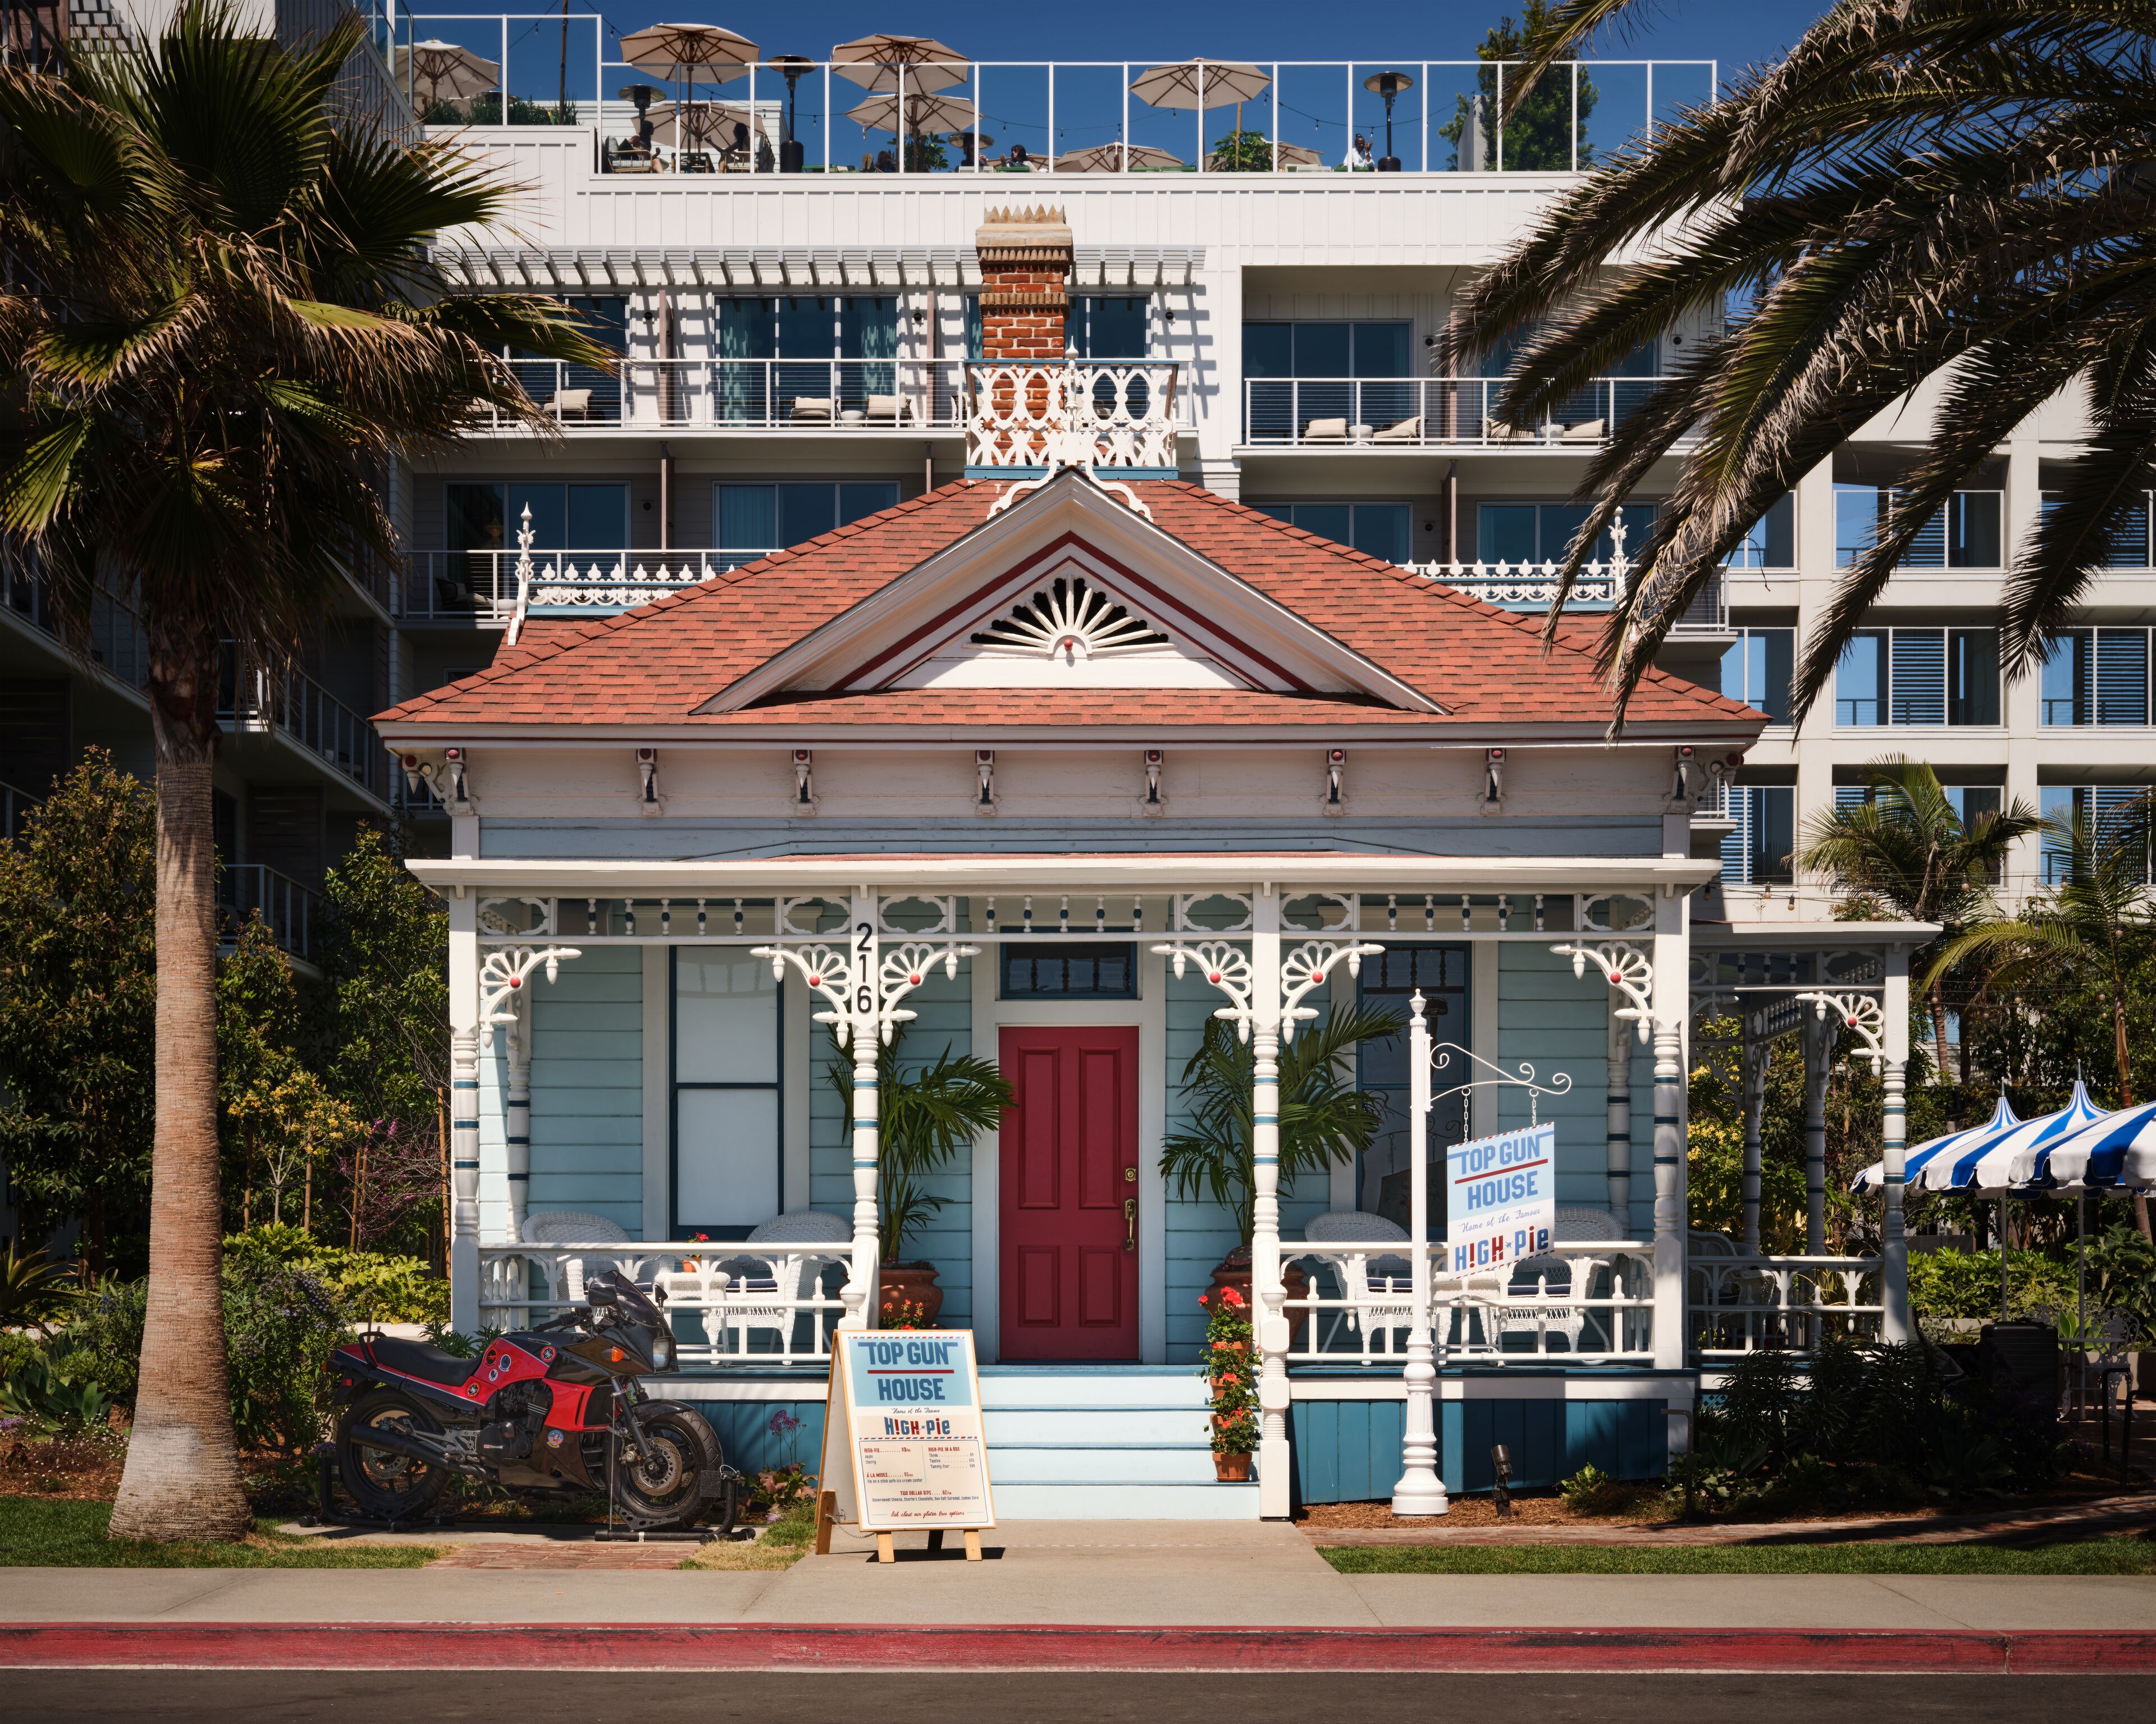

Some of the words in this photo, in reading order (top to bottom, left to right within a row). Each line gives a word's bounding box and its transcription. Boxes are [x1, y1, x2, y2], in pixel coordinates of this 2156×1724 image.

[856, 922, 873, 1013] 216
[1447, 1145, 1496, 1175] TOP
[1499, 1130, 1554, 1165] GUN
[1468, 1170, 1538, 1210] HOUSE
[1458, 1223, 1483, 1233] Home
[1486, 1217, 1495, 1227] of
[1498, 1213, 1510, 1224] the
[1514, 1208, 1541, 1220] Famous
[858, 1342, 904, 1365] TOP
[906, 1342, 958, 1365] GUN
[878, 1378, 945, 1401] HOUSE
